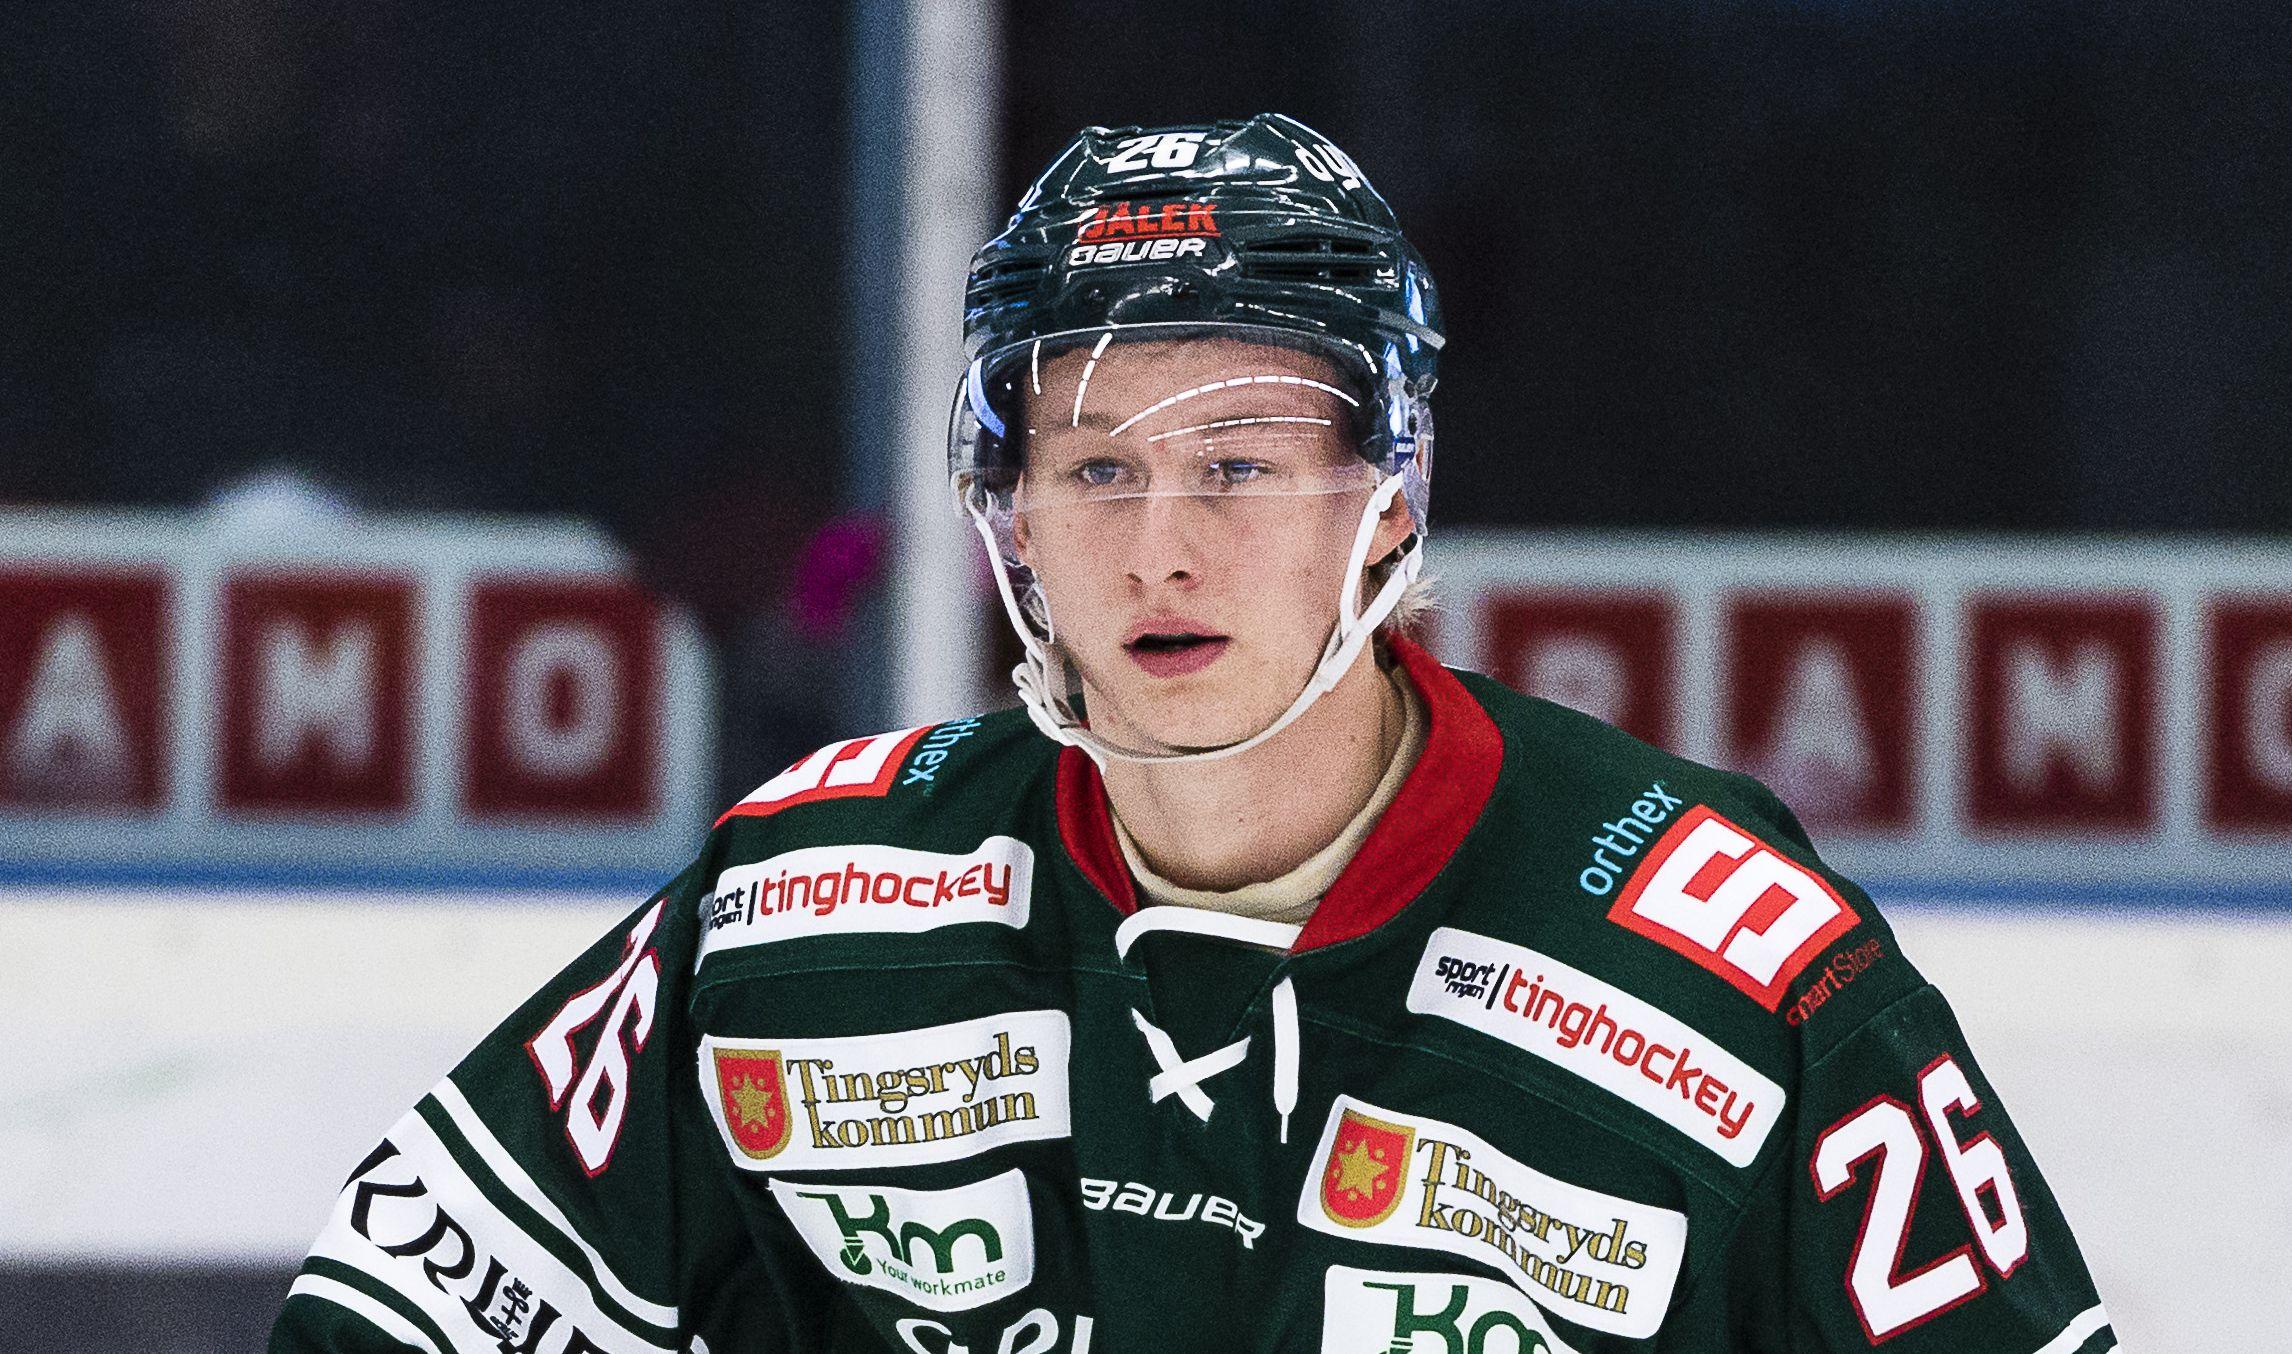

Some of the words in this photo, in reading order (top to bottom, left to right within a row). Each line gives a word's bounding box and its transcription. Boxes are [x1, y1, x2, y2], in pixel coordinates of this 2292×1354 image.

[1107, 133, 1208, 173] 26
[1580, 783, 1683, 895] orthex
[1435, 956, 1495, 985] sport
[523, 896, 670, 1178] 26
[787, 1032, 1040, 1114] Tingsryds
[807, 1087, 1040, 1150] kommun
[1417, 1138, 1648, 1270] Tingsryds
[1810, 1052, 2029, 1345] 26
[876, 1258, 908, 1283] Your
[910, 1270, 1006, 1296] workmate
[1415, 1182, 1630, 1314] kommun
